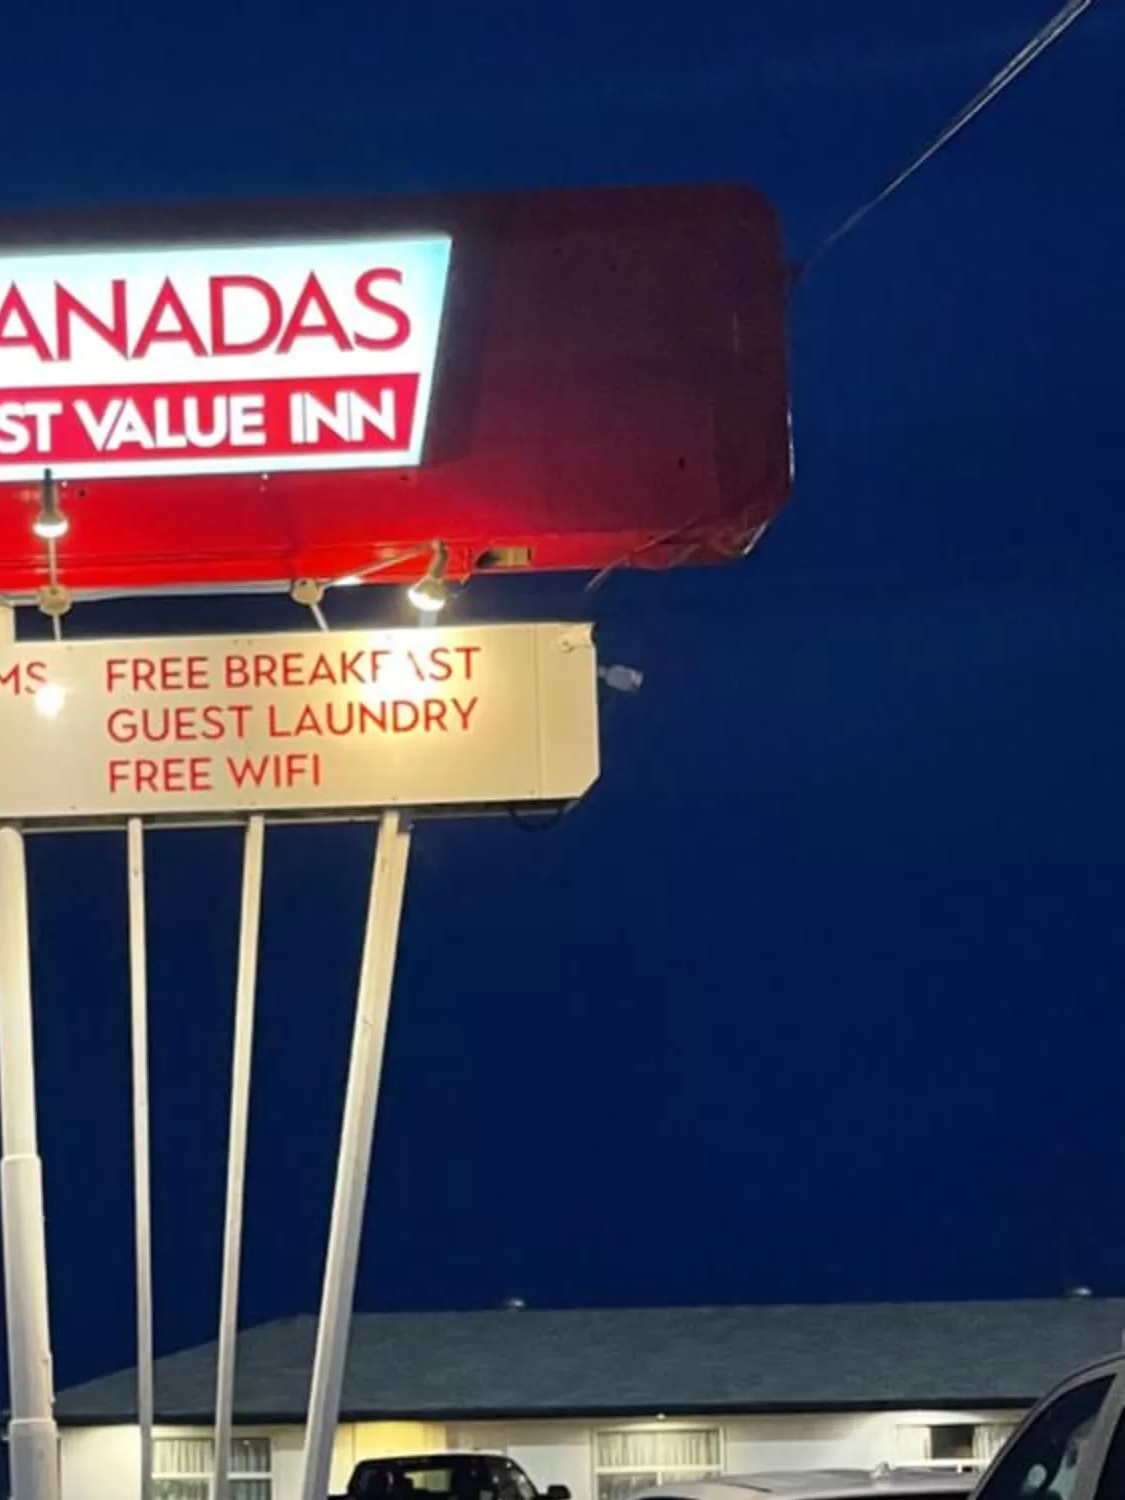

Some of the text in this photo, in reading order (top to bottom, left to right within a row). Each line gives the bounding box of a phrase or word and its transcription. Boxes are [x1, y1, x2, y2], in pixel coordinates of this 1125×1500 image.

[74, 394, 266, 451] VALUE
[290, 388, 396, 444] INN
[106, 652, 210, 692] FREE
[106, 696, 480, 744] GUEST LAUNDRY
[107, 752, 322, 794] FREE WIFI
